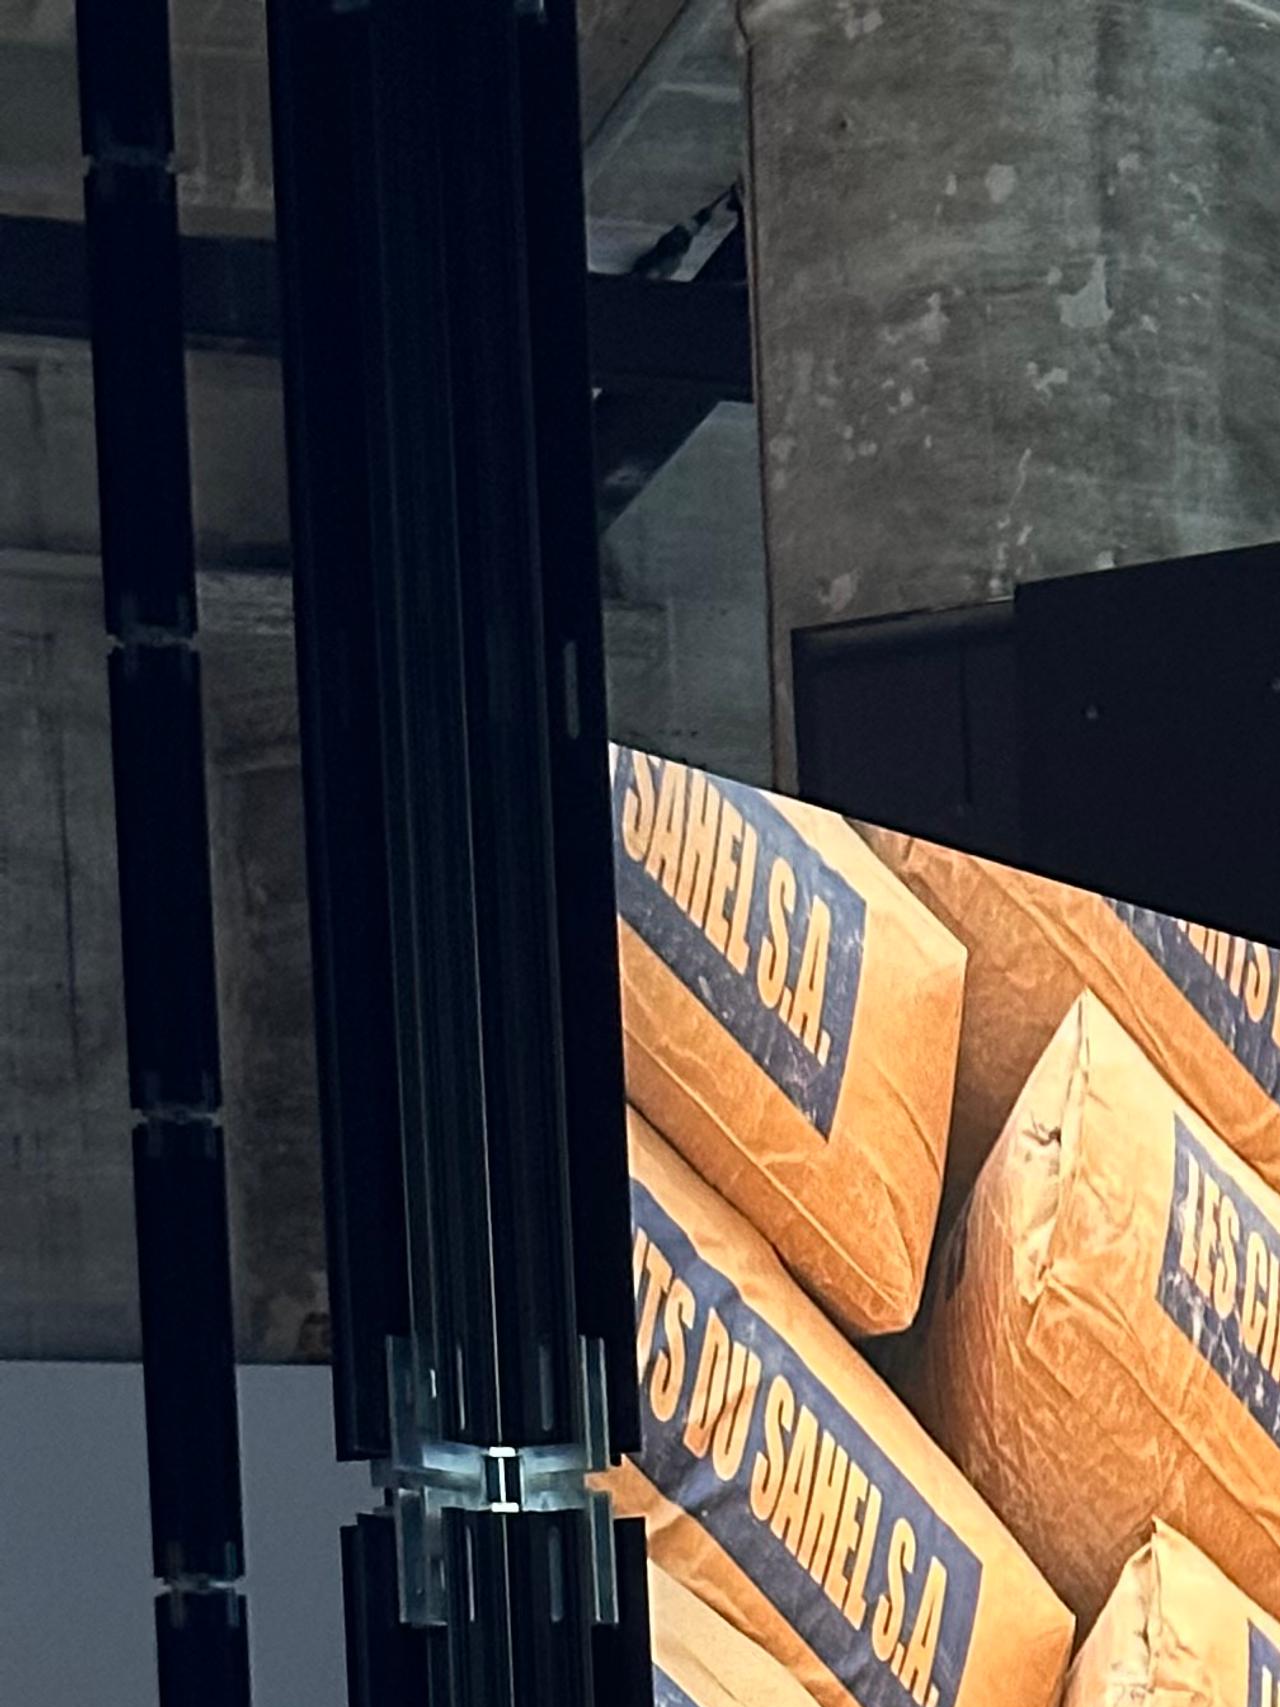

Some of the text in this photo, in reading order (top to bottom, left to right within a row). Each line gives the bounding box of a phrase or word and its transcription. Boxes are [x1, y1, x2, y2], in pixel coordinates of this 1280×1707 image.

[622, 748, 832, 1069] SAHEL S.A.
[1179, 1150, 1240, 1320] LES
[683, 1307, 762, 1482] DU
[750, 1374, 882, 1631] SAHEL
